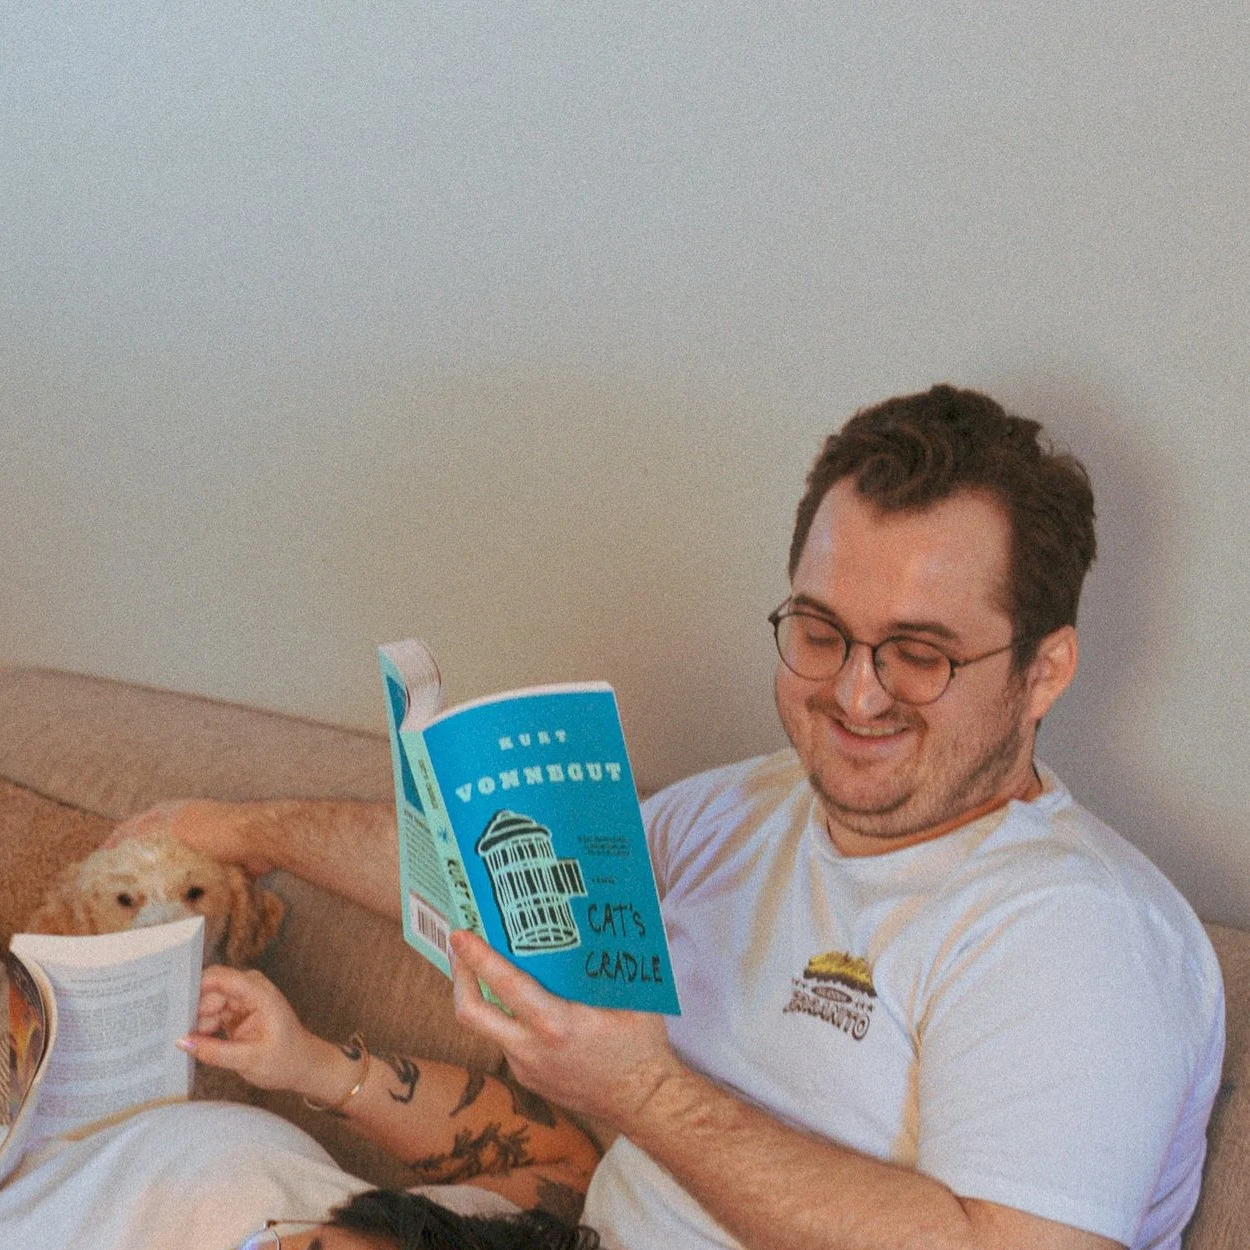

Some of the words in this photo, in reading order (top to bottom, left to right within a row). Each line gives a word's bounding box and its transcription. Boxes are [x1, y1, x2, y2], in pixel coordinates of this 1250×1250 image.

[498, 728, 566, 751] KURT
[455, 762, 621, 803] VONNEGUT
[587, 902, 646, 938] CAT'S
[584, 951, 664, 984] CRADLE
